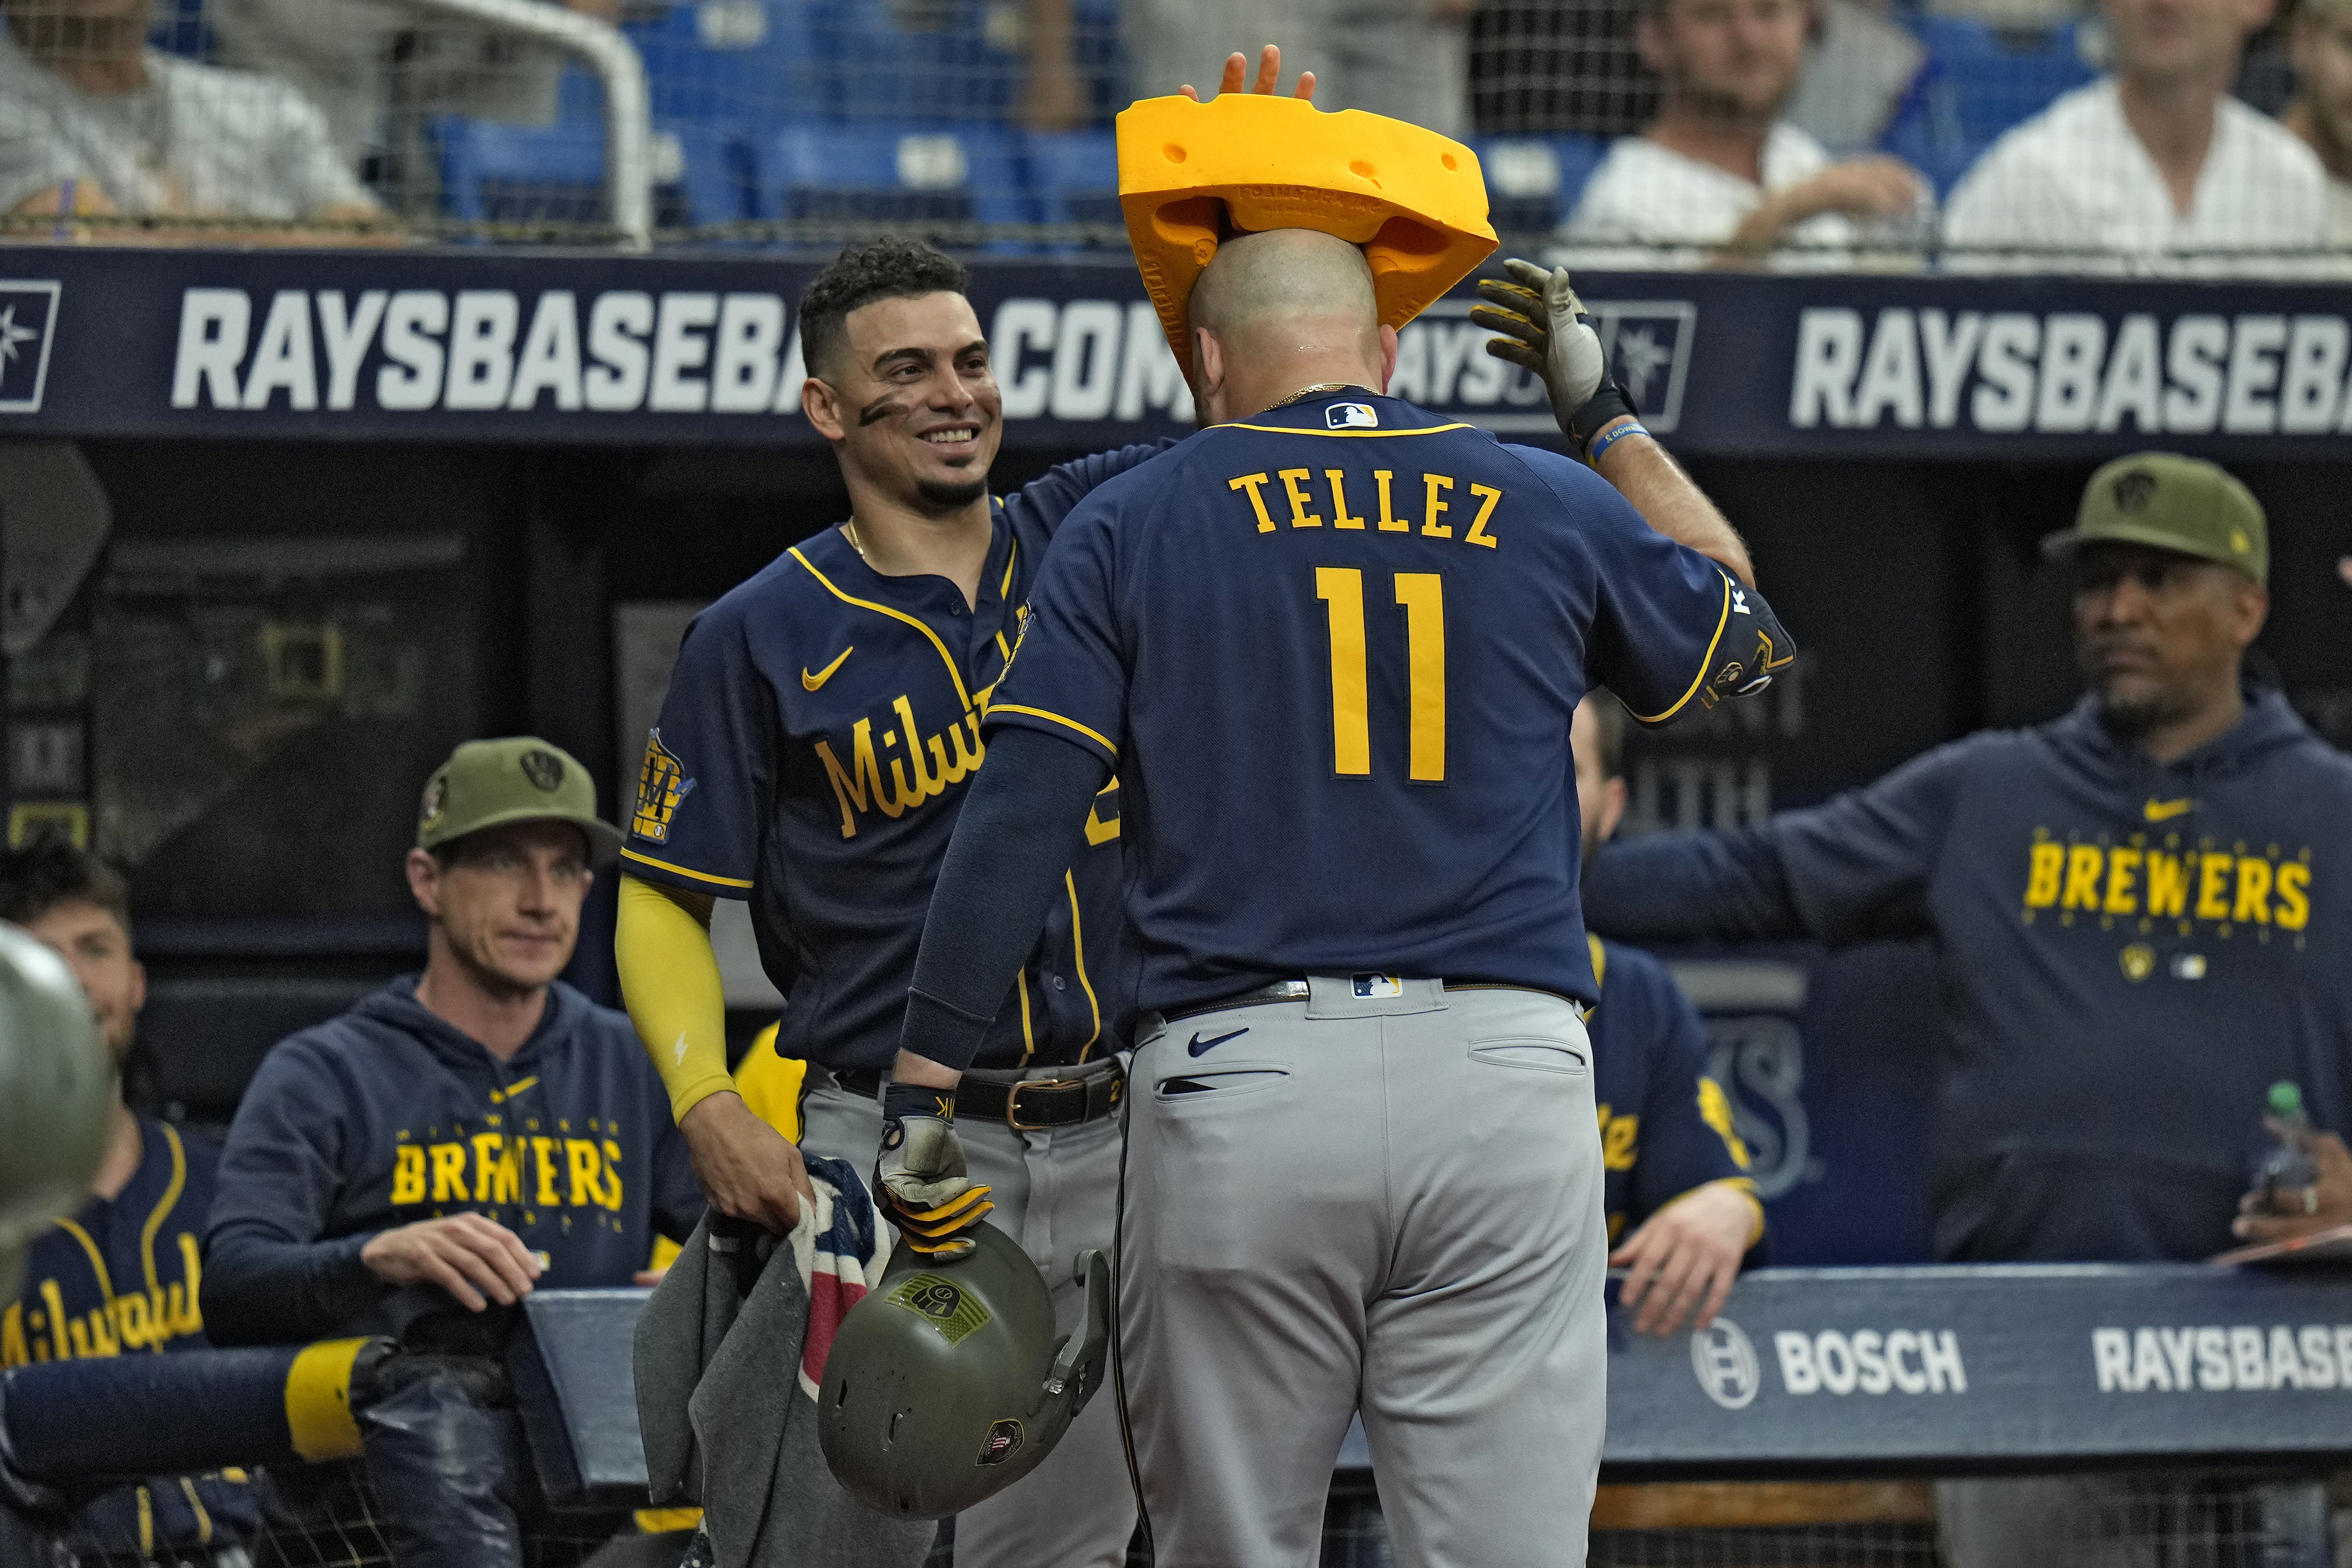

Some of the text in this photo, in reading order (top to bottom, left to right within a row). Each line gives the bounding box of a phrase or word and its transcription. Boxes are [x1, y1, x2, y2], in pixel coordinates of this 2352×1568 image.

[1789, 306, 2352, 435] RAYSBASEB
[1228, 468, 1503, 549] TELLEZ
[1315, 567, 1446, 781] 11
[2023, 842, 2312, 931] BREWERS
[1774, 1328, 1967, 1395] BOSCH
